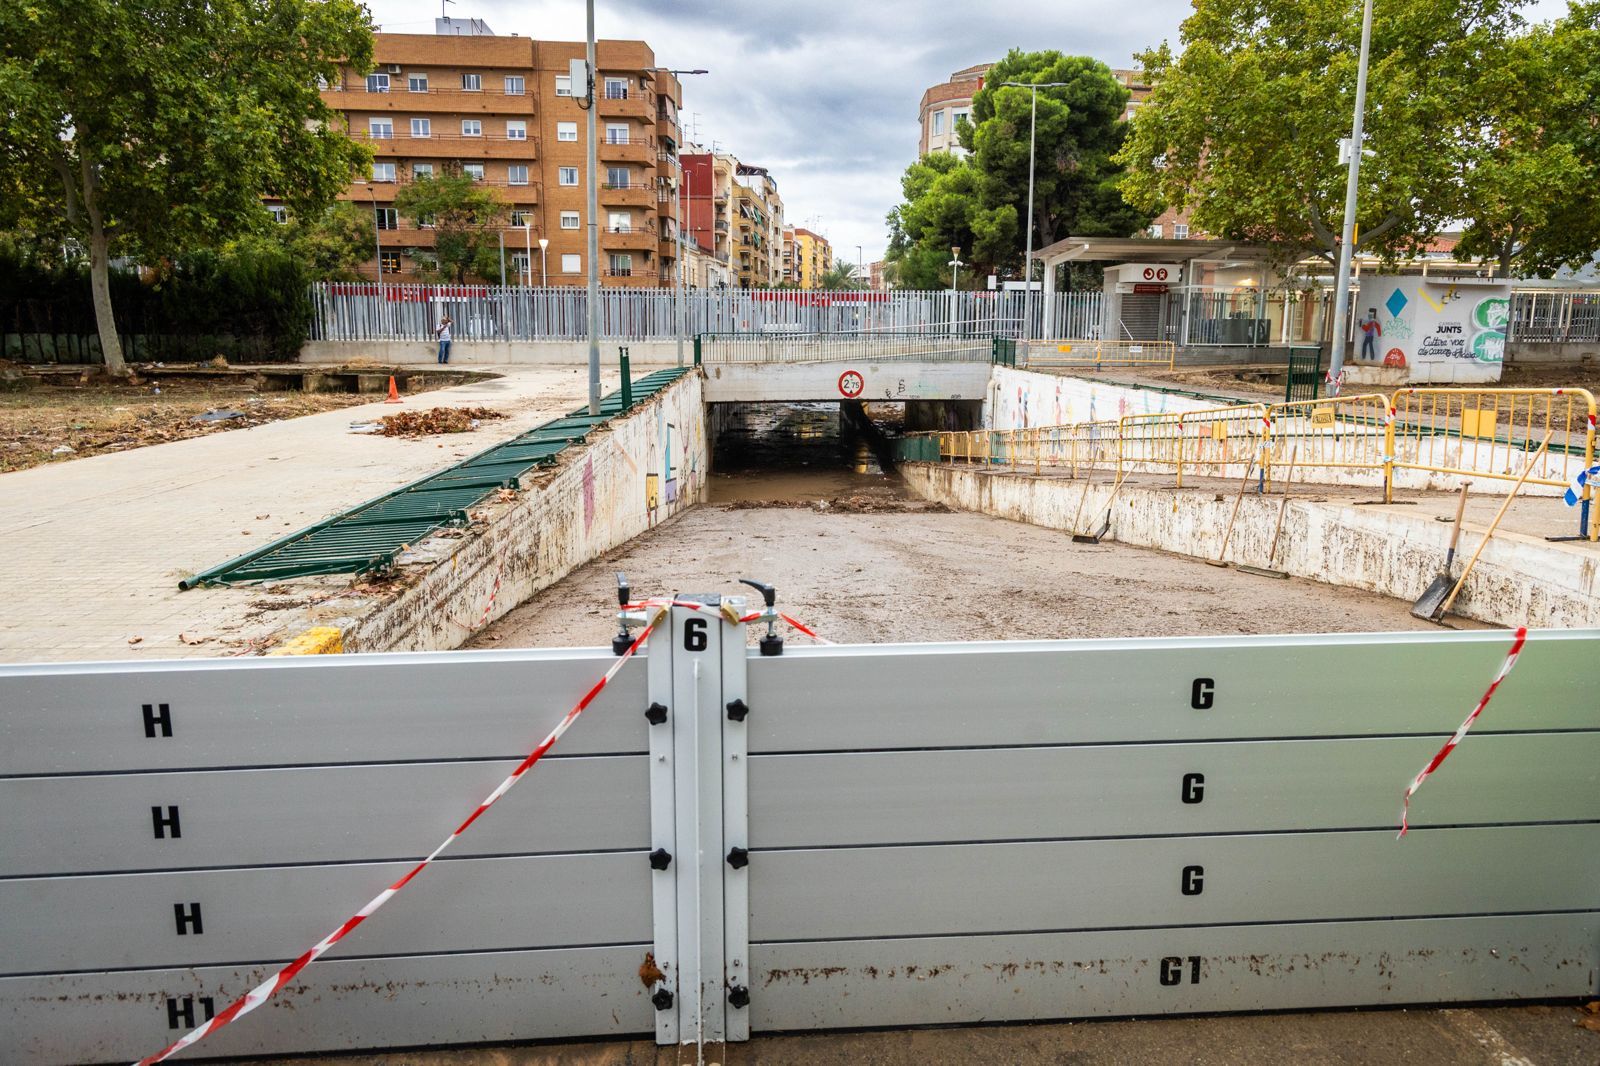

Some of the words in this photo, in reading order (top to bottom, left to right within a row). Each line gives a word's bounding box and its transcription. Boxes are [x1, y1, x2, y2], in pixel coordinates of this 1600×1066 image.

[684, 618, 707, 651] 6
[1191, 678, 1214, 709] G
[142, 704, 172, 738] H
[1182, 773, 1204, 804] G
[152, 806, 181, 839] H
[1181, 865, 1204, 895] G
[174, 903, 203, 935] H
[1160, 956, 1201, 986] G1
[167, 998, 215, 1029] H1
